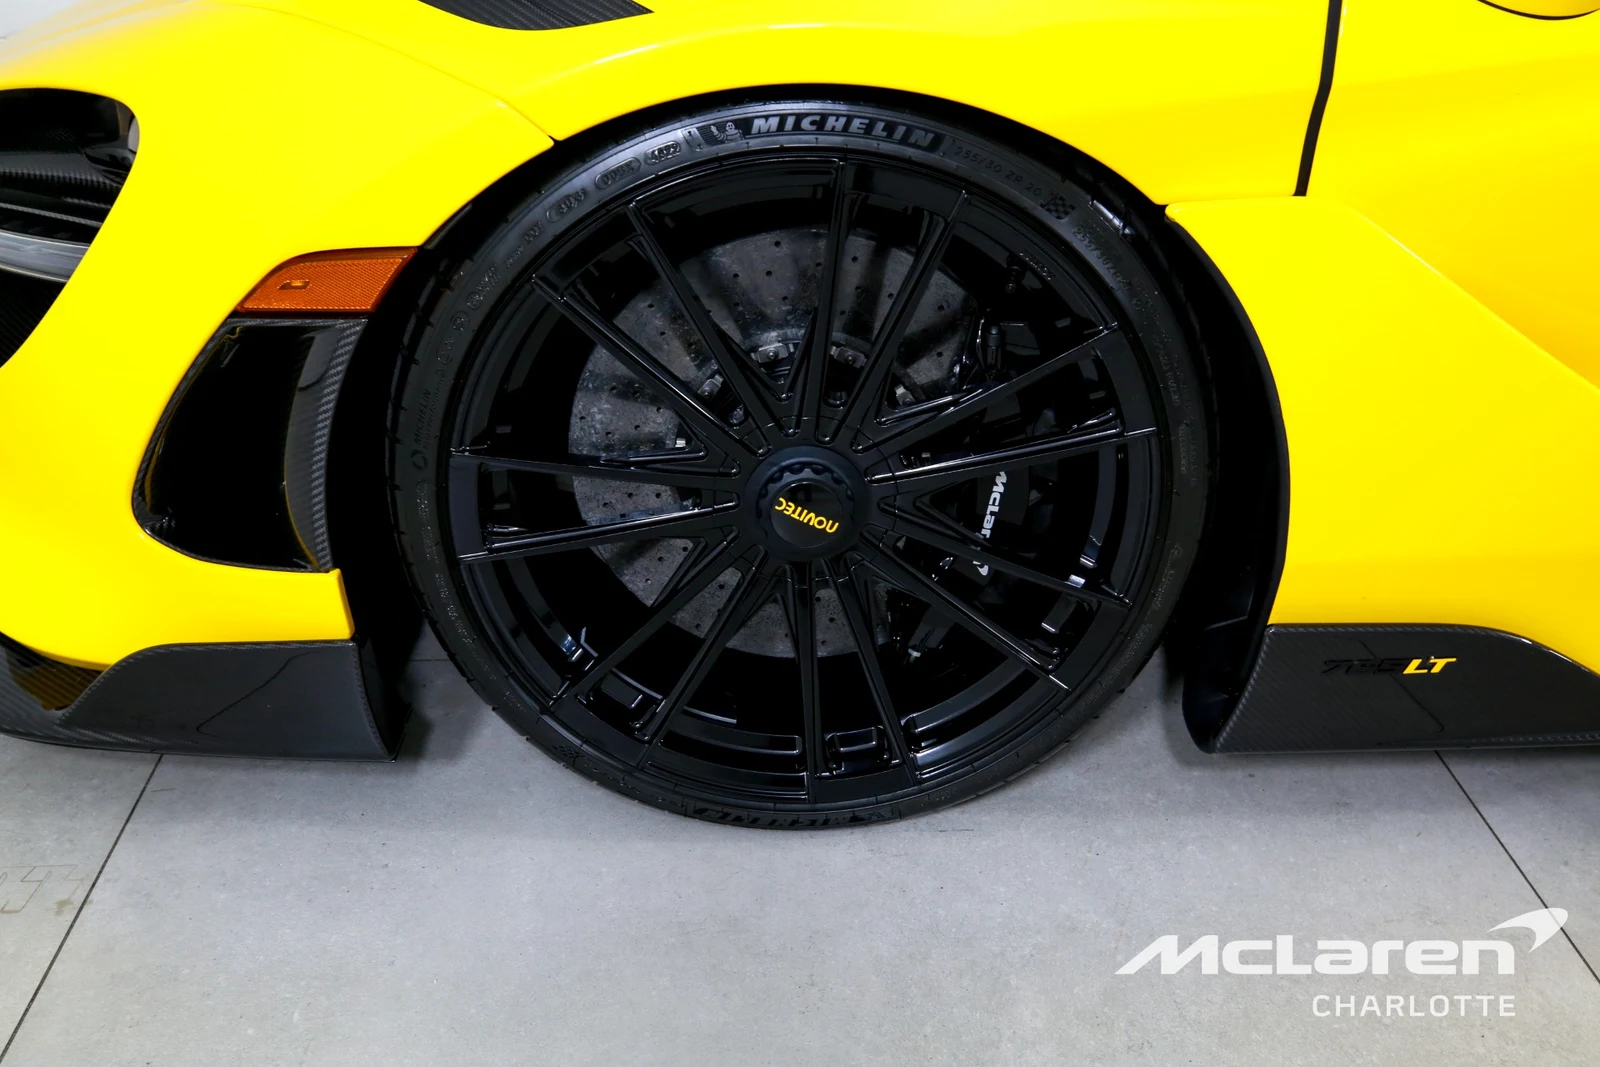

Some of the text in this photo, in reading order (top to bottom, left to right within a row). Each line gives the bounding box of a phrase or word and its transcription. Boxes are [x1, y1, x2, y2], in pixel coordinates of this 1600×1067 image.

[751, 114, 935, 148] MICHELIN
[414, 388, 431, 445] MICHELIN
[774, 497, 840, 534] NOVITEC
[975, 470, 1008, 545] McLar
